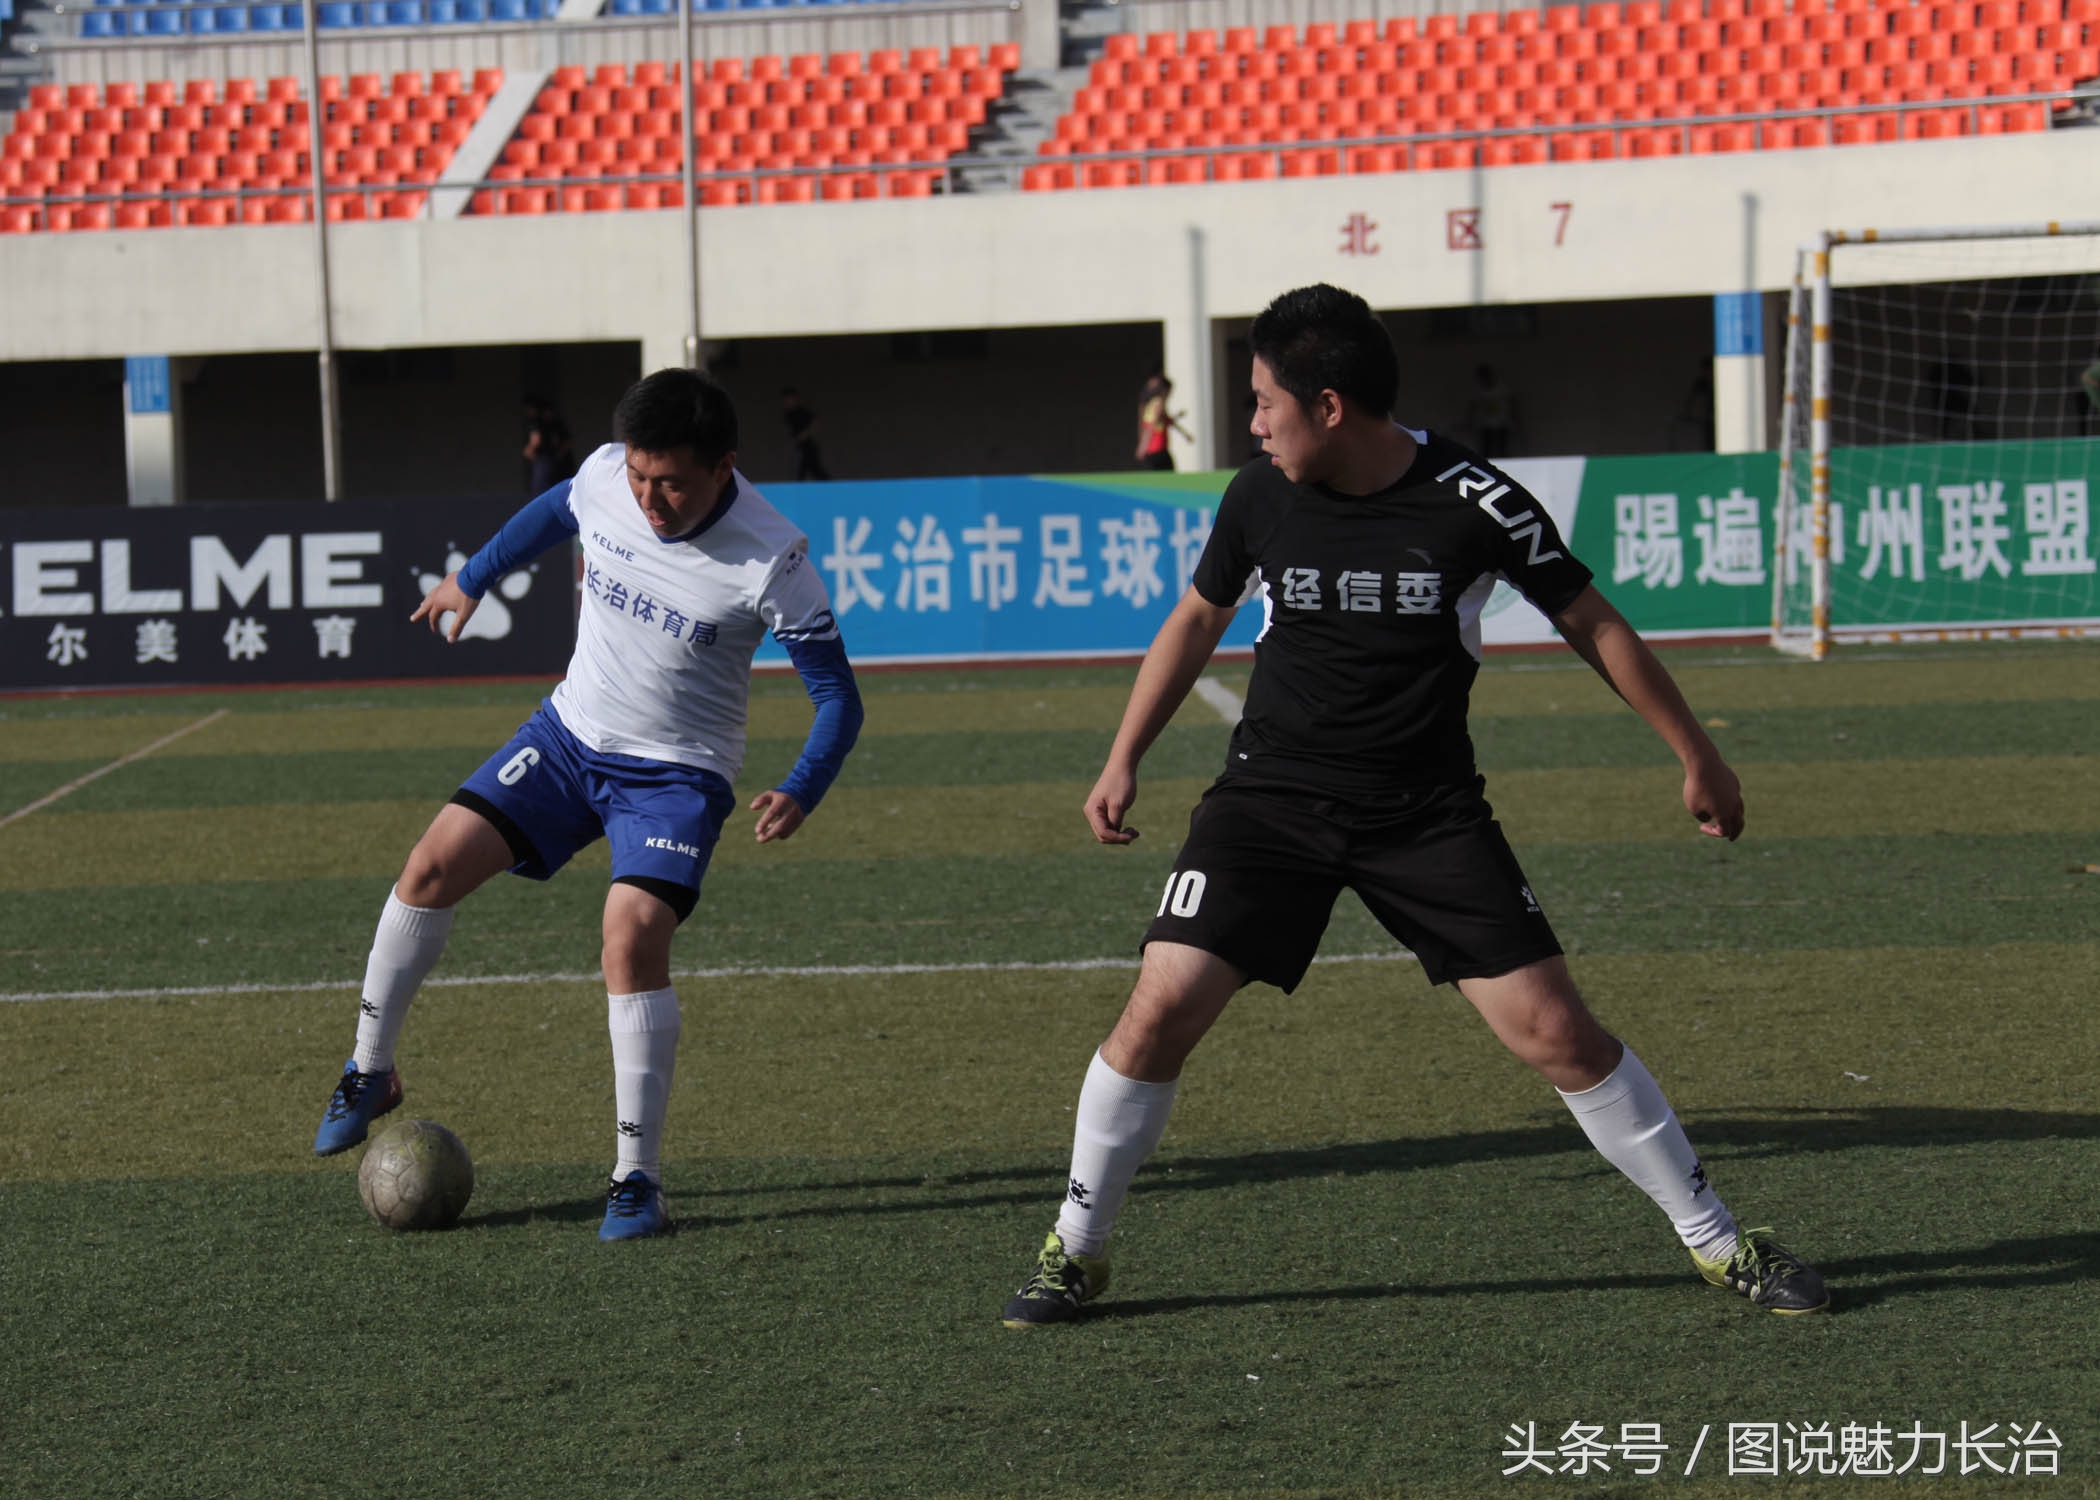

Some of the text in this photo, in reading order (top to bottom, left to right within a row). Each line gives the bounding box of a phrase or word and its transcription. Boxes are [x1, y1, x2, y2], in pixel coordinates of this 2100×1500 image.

[1435, 461, 1563, 567] RUN
[592, 531, 636, 562] KELME
[0, 532, 382, 617] ELME
[1281, 567, 1444, 615] 经信委
[587, 560, 718, 648] 长治体育局
[497, 746, 541, 786] 6
[645, 836, 699, 858] KELME
[1156, 870, 1207, 918] 10
